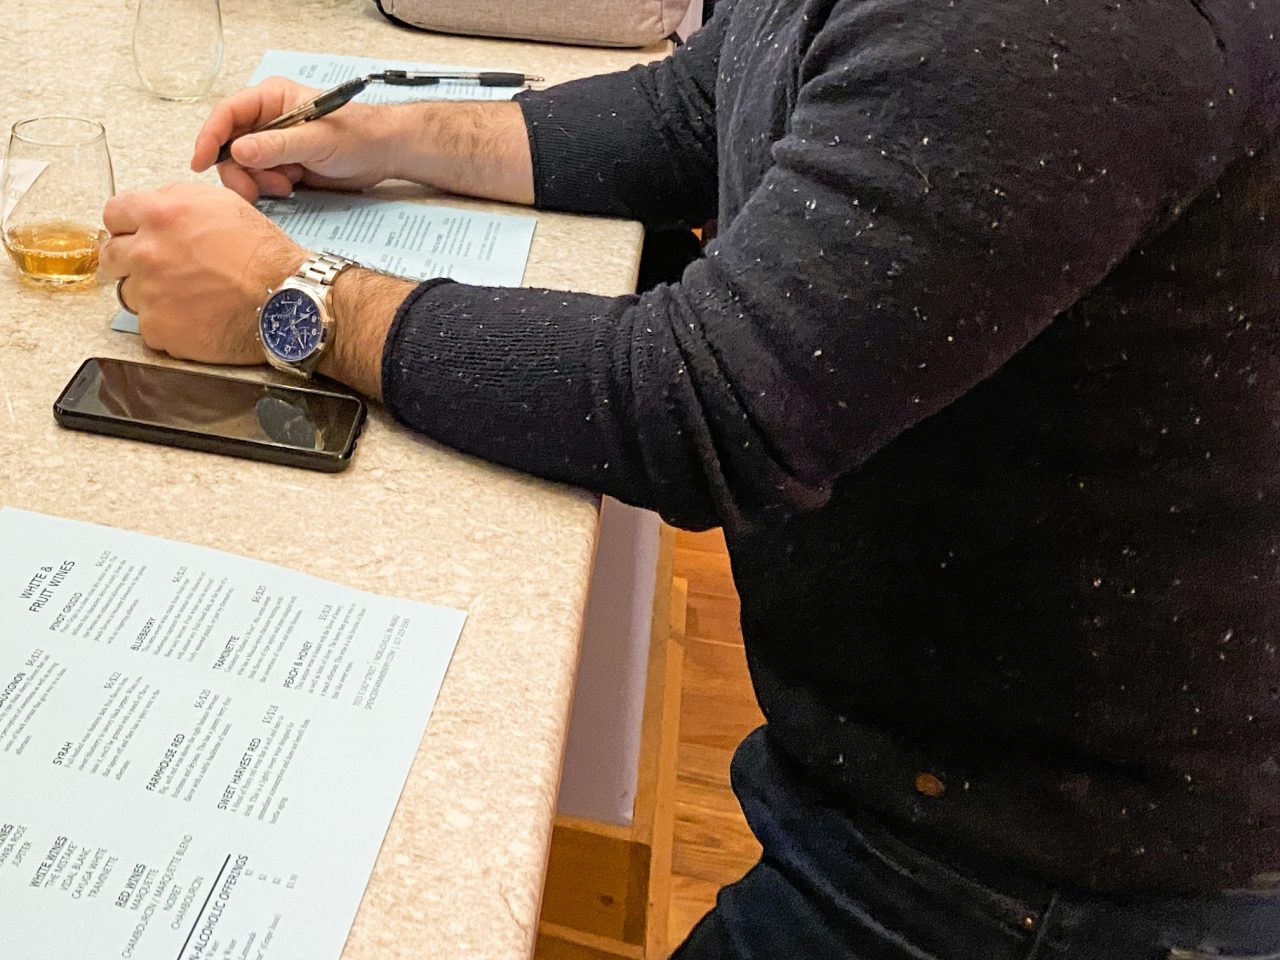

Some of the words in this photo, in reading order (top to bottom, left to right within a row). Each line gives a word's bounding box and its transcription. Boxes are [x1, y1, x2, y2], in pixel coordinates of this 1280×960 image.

[20, 573, 47, 598] WHITE
[29, 588, 53, 612] FRUIT
[48, 561, 75, 586] WINES
[131, 617, 155, 651] BLUEBERRY
[283, 667, 299, 688] PEACH
[297, 641, 312, 660] HONEY
[53, 742, 73, 765] SYRAH
[146, 749, 177, 791] FARMHOUSE
[171, 734, 185, 747] RED
[217, 785, 236, 810] SWEET
[231, 752, 252, 784] HARVEST
[248, 738, 261, 751] RED
[29, 862, 52, 887] WHITE
[45, 836, 68, 862] WINES
[72, 847, 91, 870] BLANC
[88, 848, 107, 869] WHITE
[219, 854, 248, 900] OFFERINGS
[115, 891, 133, 908] RED
[125, 864, 147, 890] WINES
